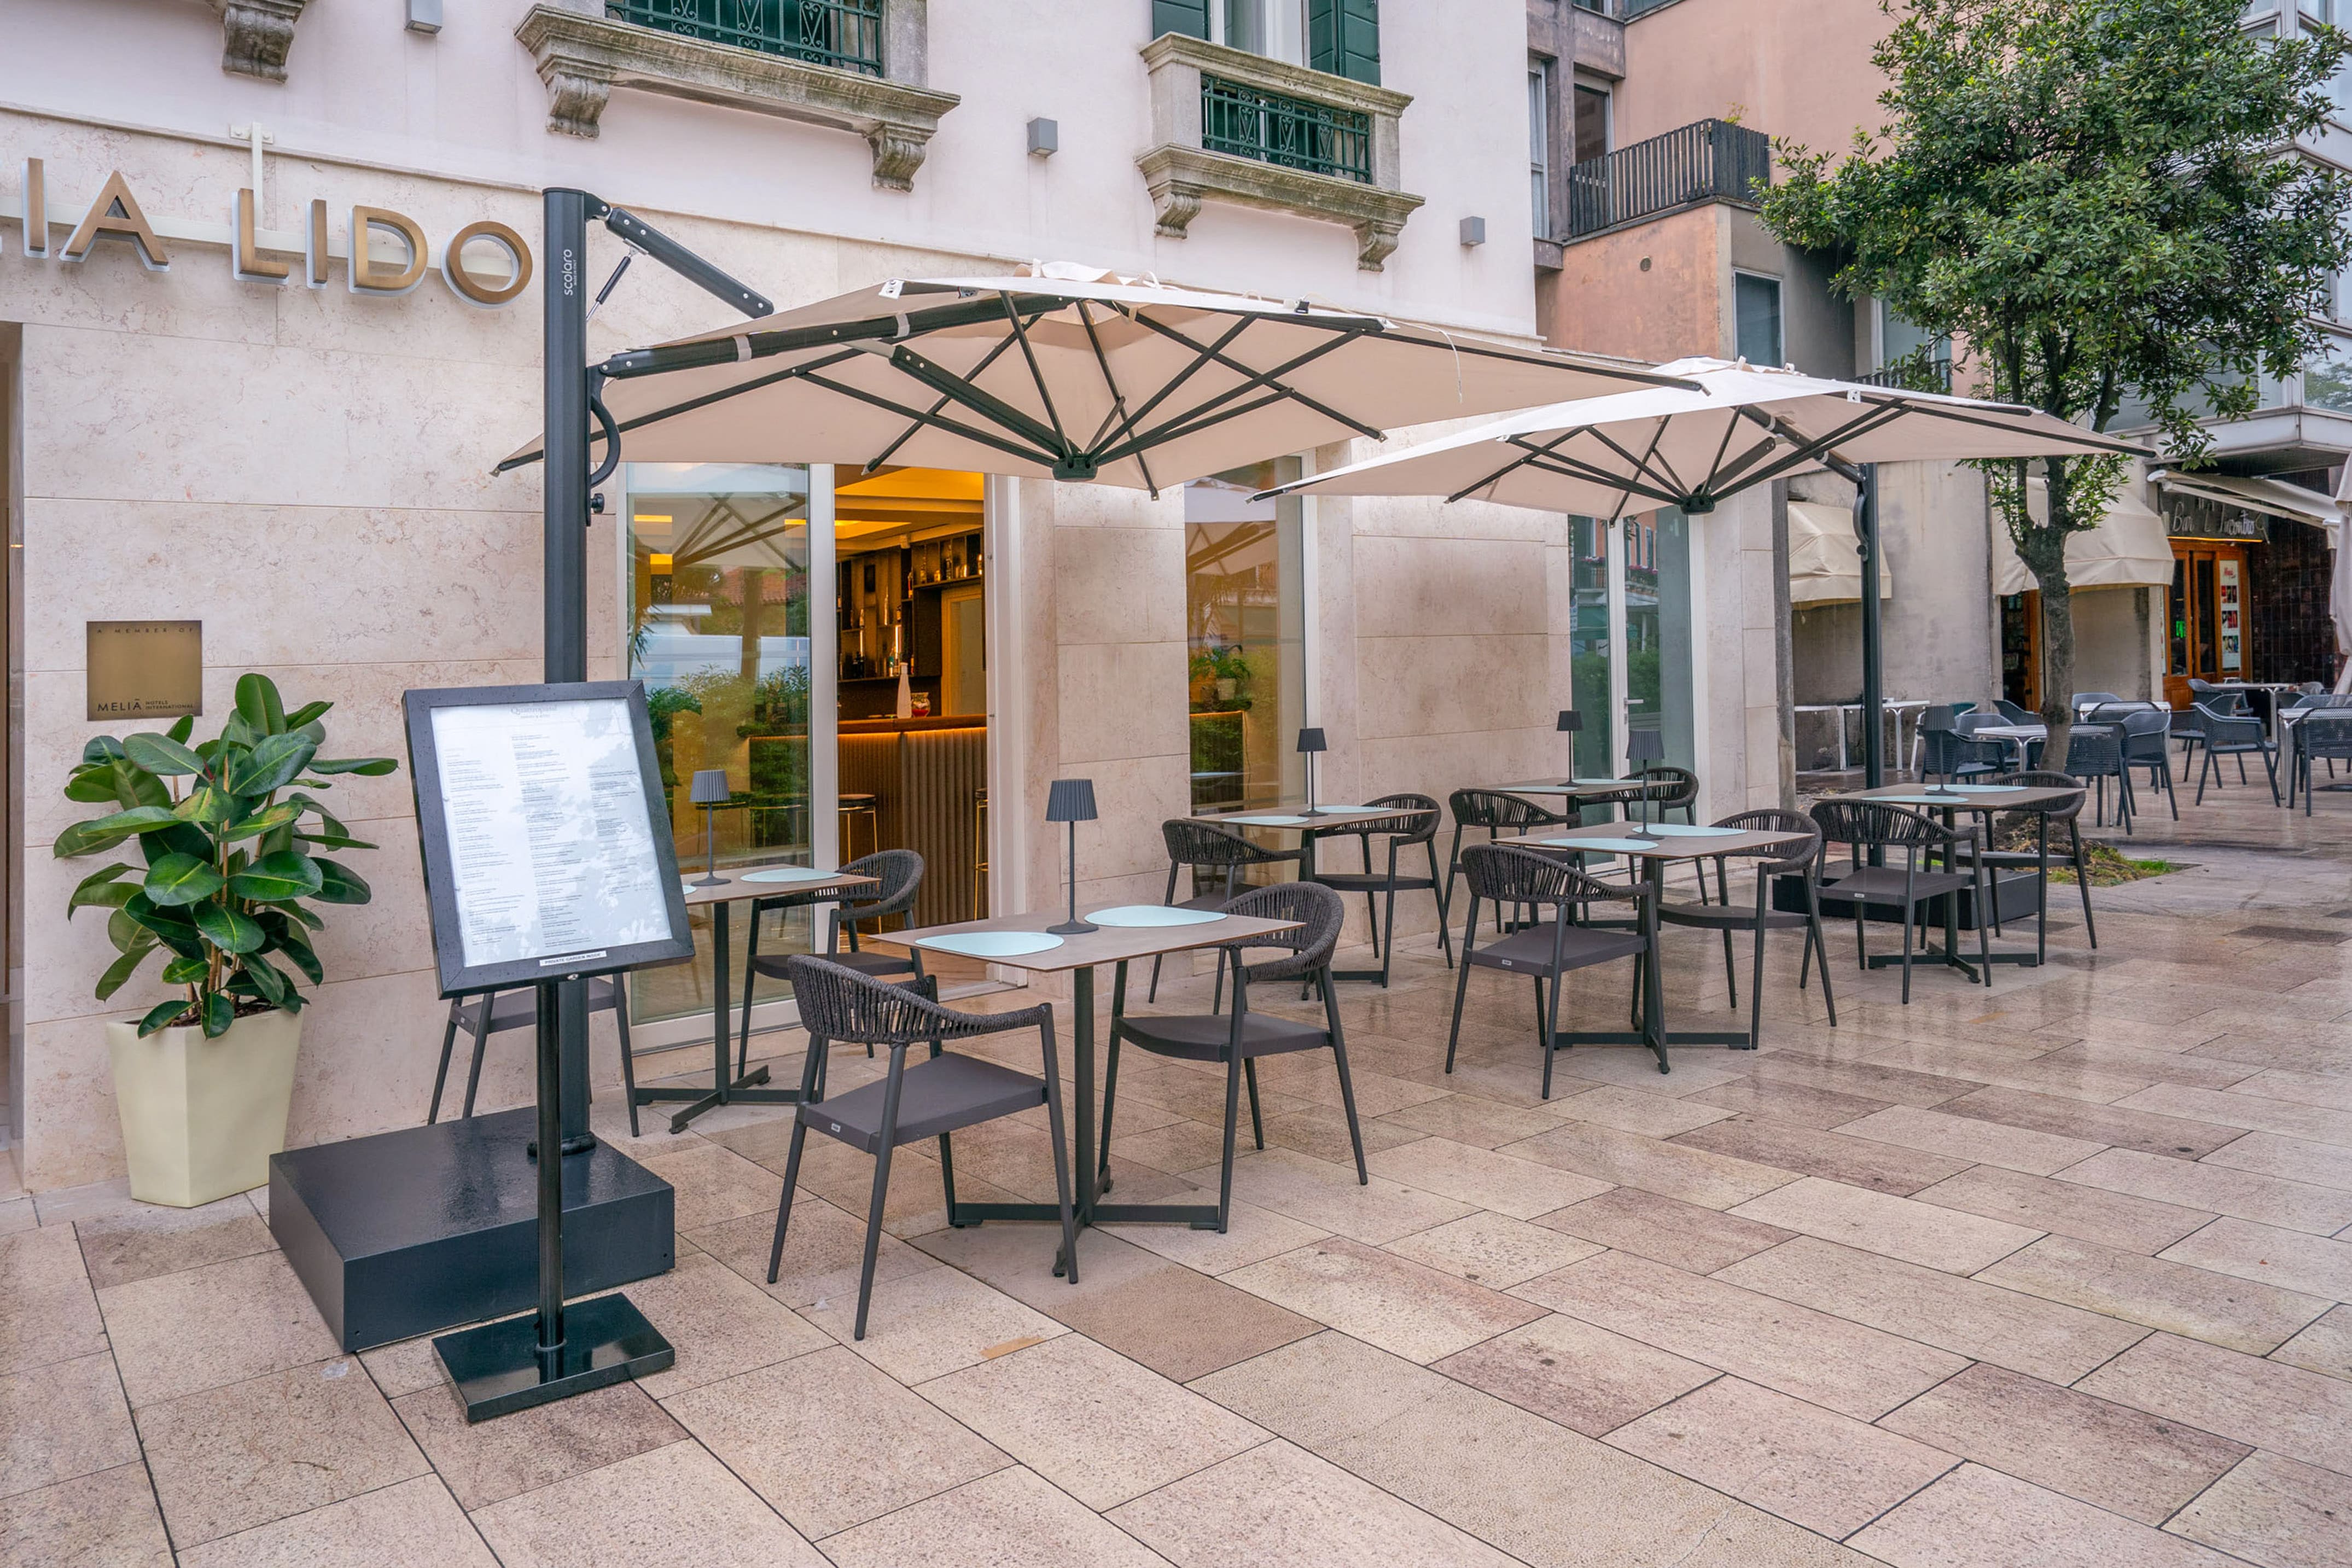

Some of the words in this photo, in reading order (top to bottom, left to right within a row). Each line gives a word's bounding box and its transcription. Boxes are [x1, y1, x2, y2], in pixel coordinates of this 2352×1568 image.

[22, 157, 169, 271] IA
[233, 188, 533, 307] LIDO
[562, 249, 573, 296] scolaro
